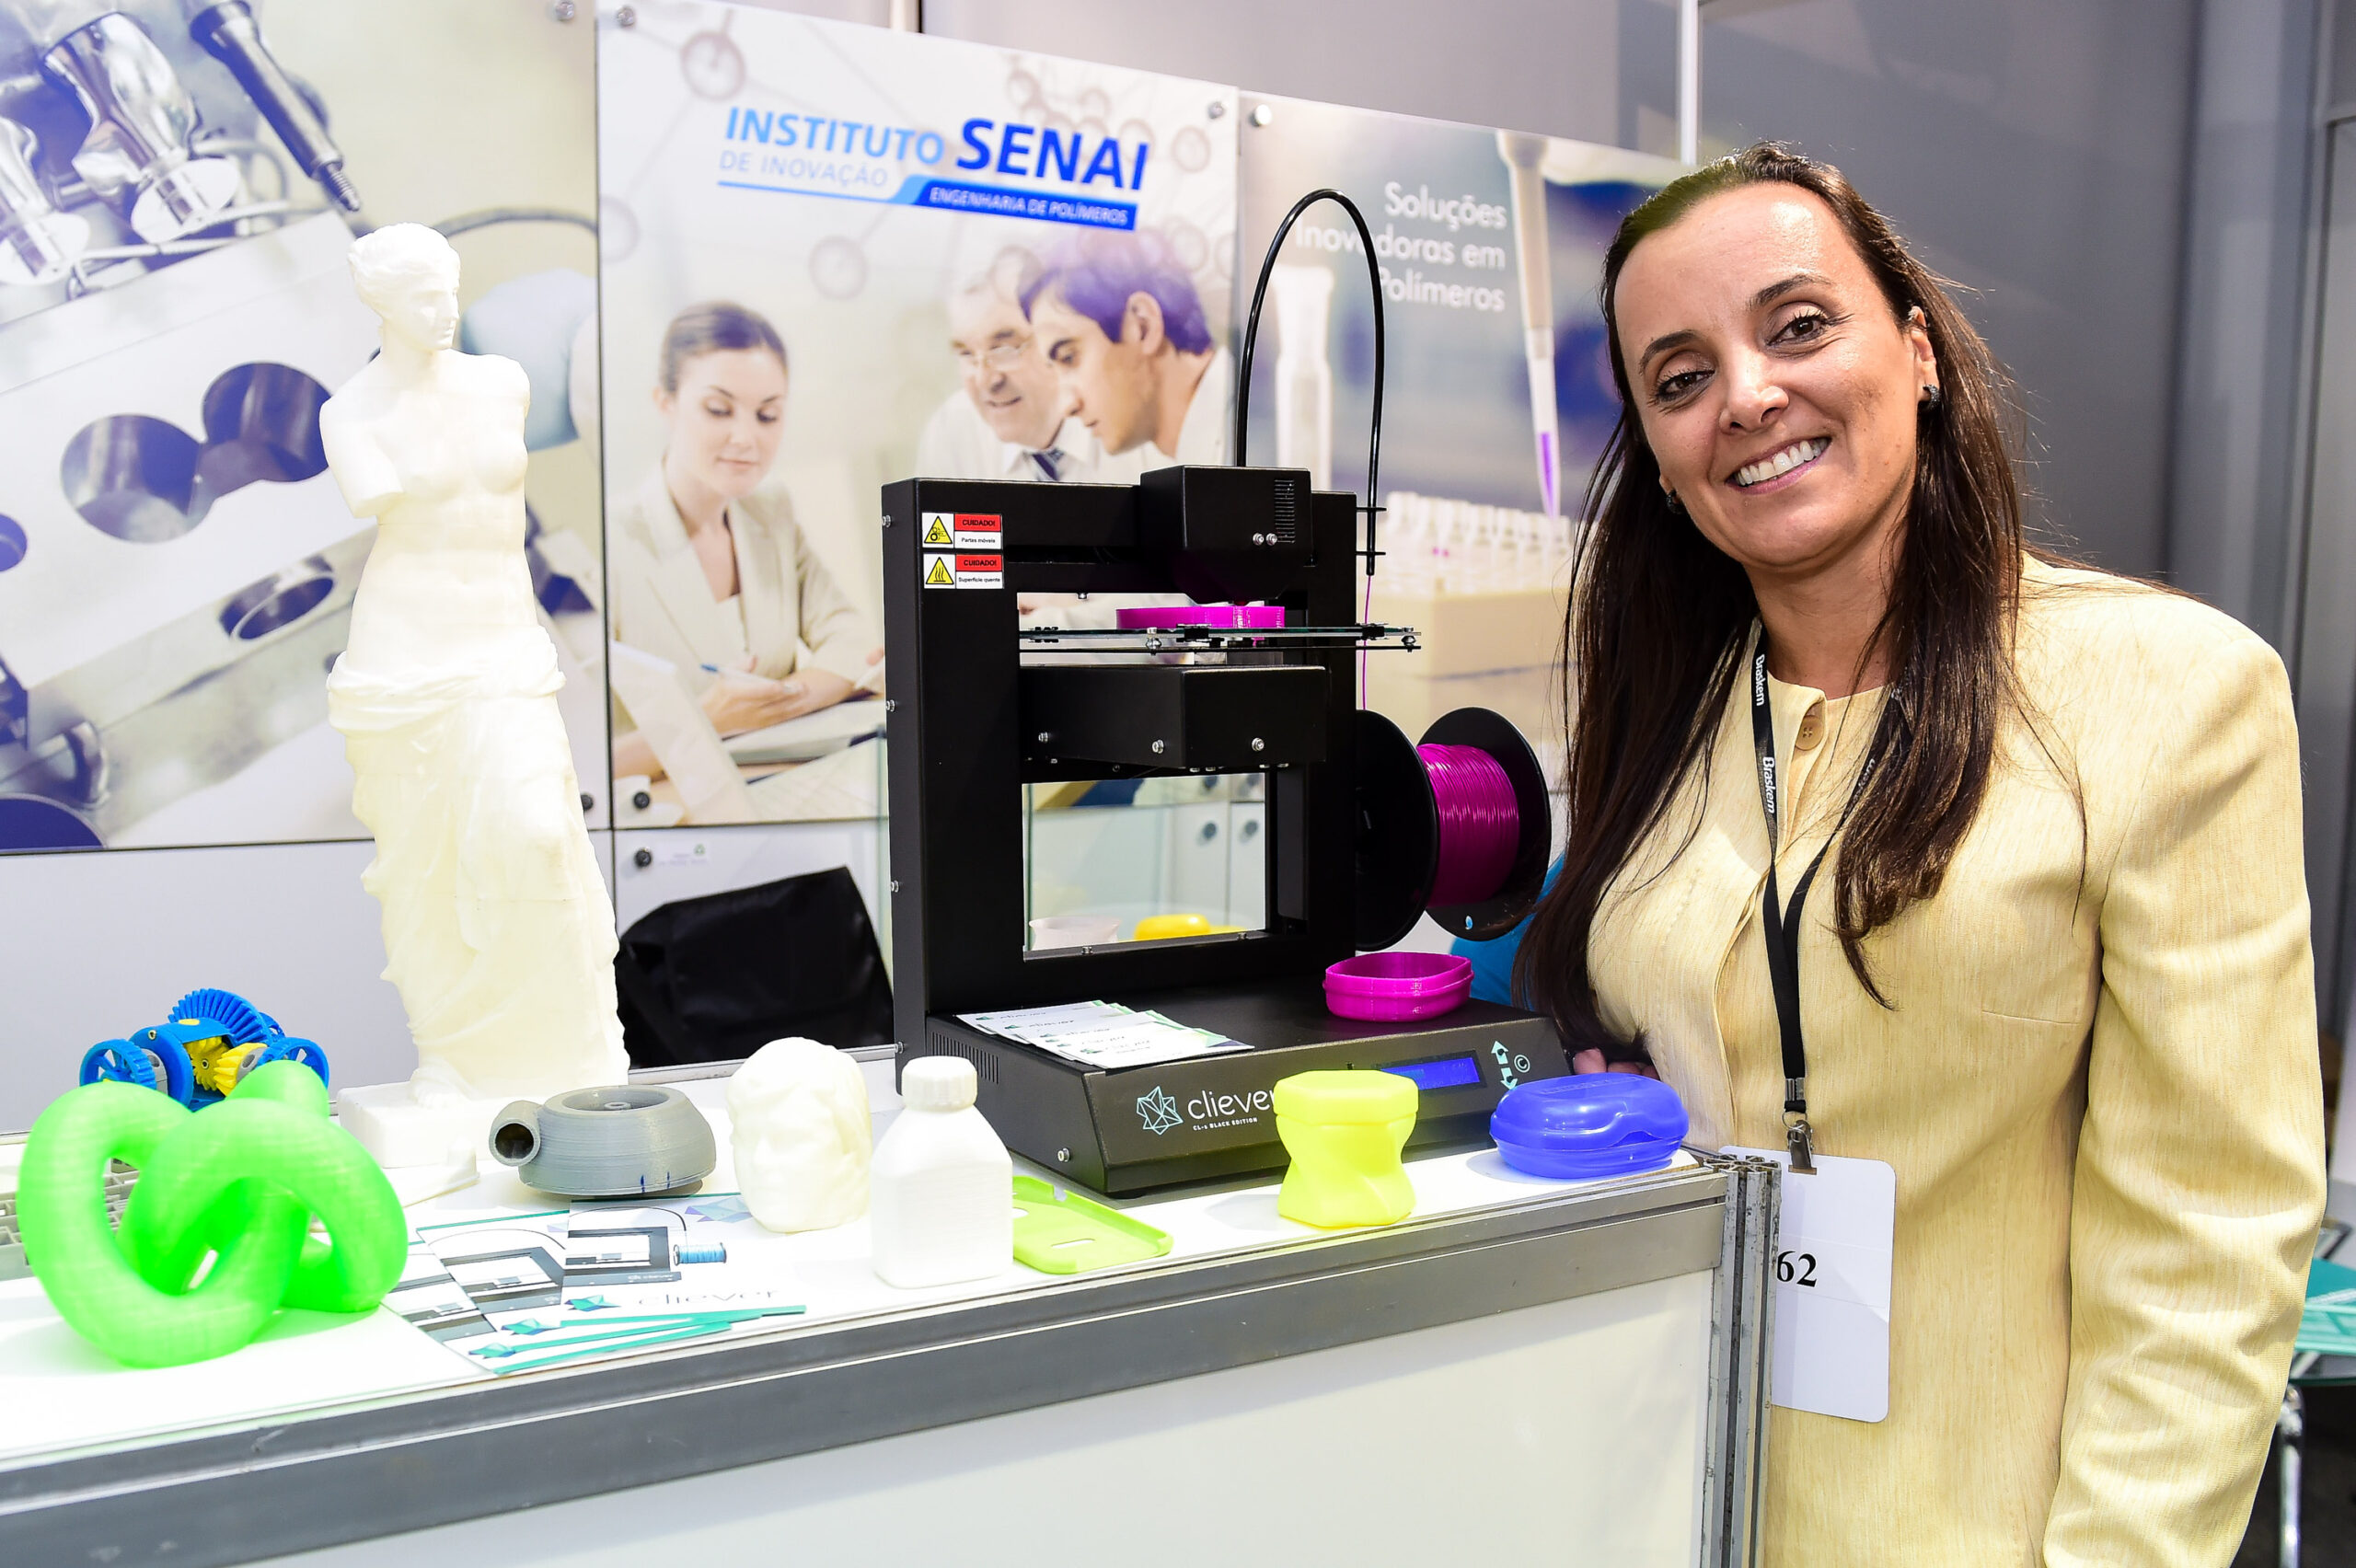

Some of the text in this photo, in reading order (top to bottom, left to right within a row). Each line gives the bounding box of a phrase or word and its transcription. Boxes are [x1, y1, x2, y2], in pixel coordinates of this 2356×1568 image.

[726, 107, 1150, 191] INSTITUTO SENAI
[719, 150, 888, 187] DE INOVAÇÃO
[930, 187, 1128, 225] ENGENHARIA DE POLÍMEROS
[1384, 181, 1507, 232] Soluções
[1461, 243, 1506, 270] em
[962, 519, 996, 527] CUIDADO!
[1754, 653, 1765, 707] Braskem
[1762, 756, 1775, 814] Braskem
[1231, 1117, 1258, 1125] EDITION
[1776, 1251, 1818, 1287] 62
